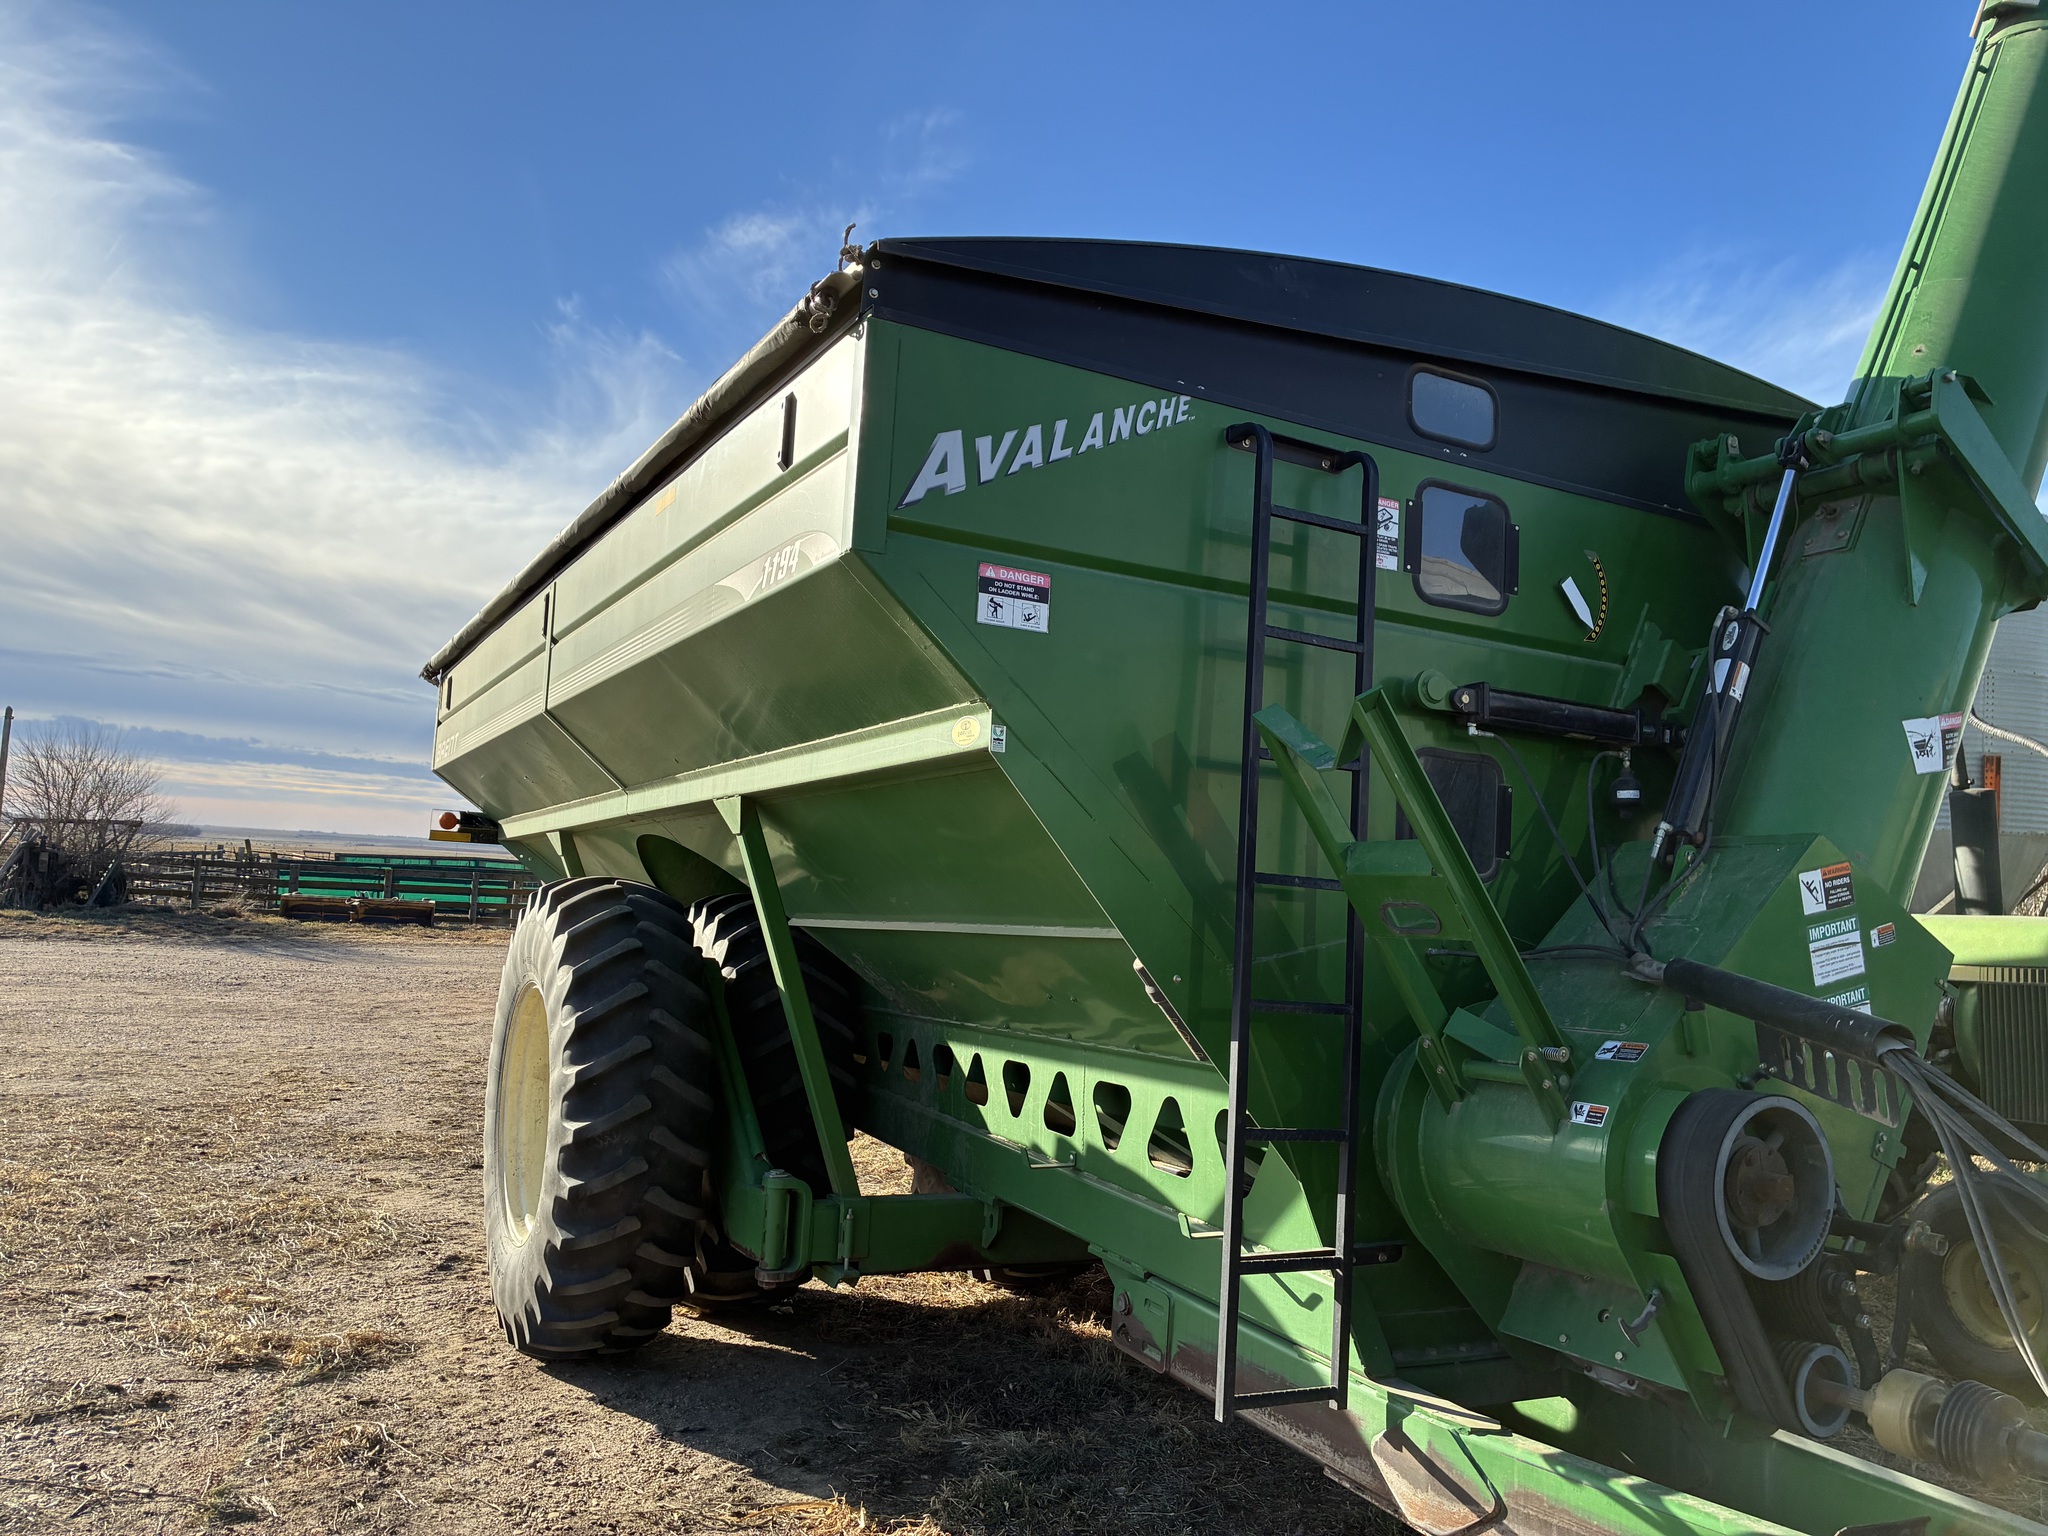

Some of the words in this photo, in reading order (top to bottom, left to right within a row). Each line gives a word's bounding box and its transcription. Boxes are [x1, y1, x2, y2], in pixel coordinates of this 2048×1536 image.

[896, 395, 1191, 511] AVALANCHE
[1377, 498, 1399, 509] ANGER
[762, 539, 801, 589] 1194
[1000, 569, 1045, 585] DANGER
[998, 588, 1020, 597] LADDER
[1016, 585, 1035, 593] STAND
[1827, 865, 1850, 876] WARNING
[1824, 880, 1832, 888] NO
[1832, 877, 1851, 887] RIDERS
[1809, 917, 1857, 941] IMPORTANT
[1824, 987, 1865, 1006] PORTANT
